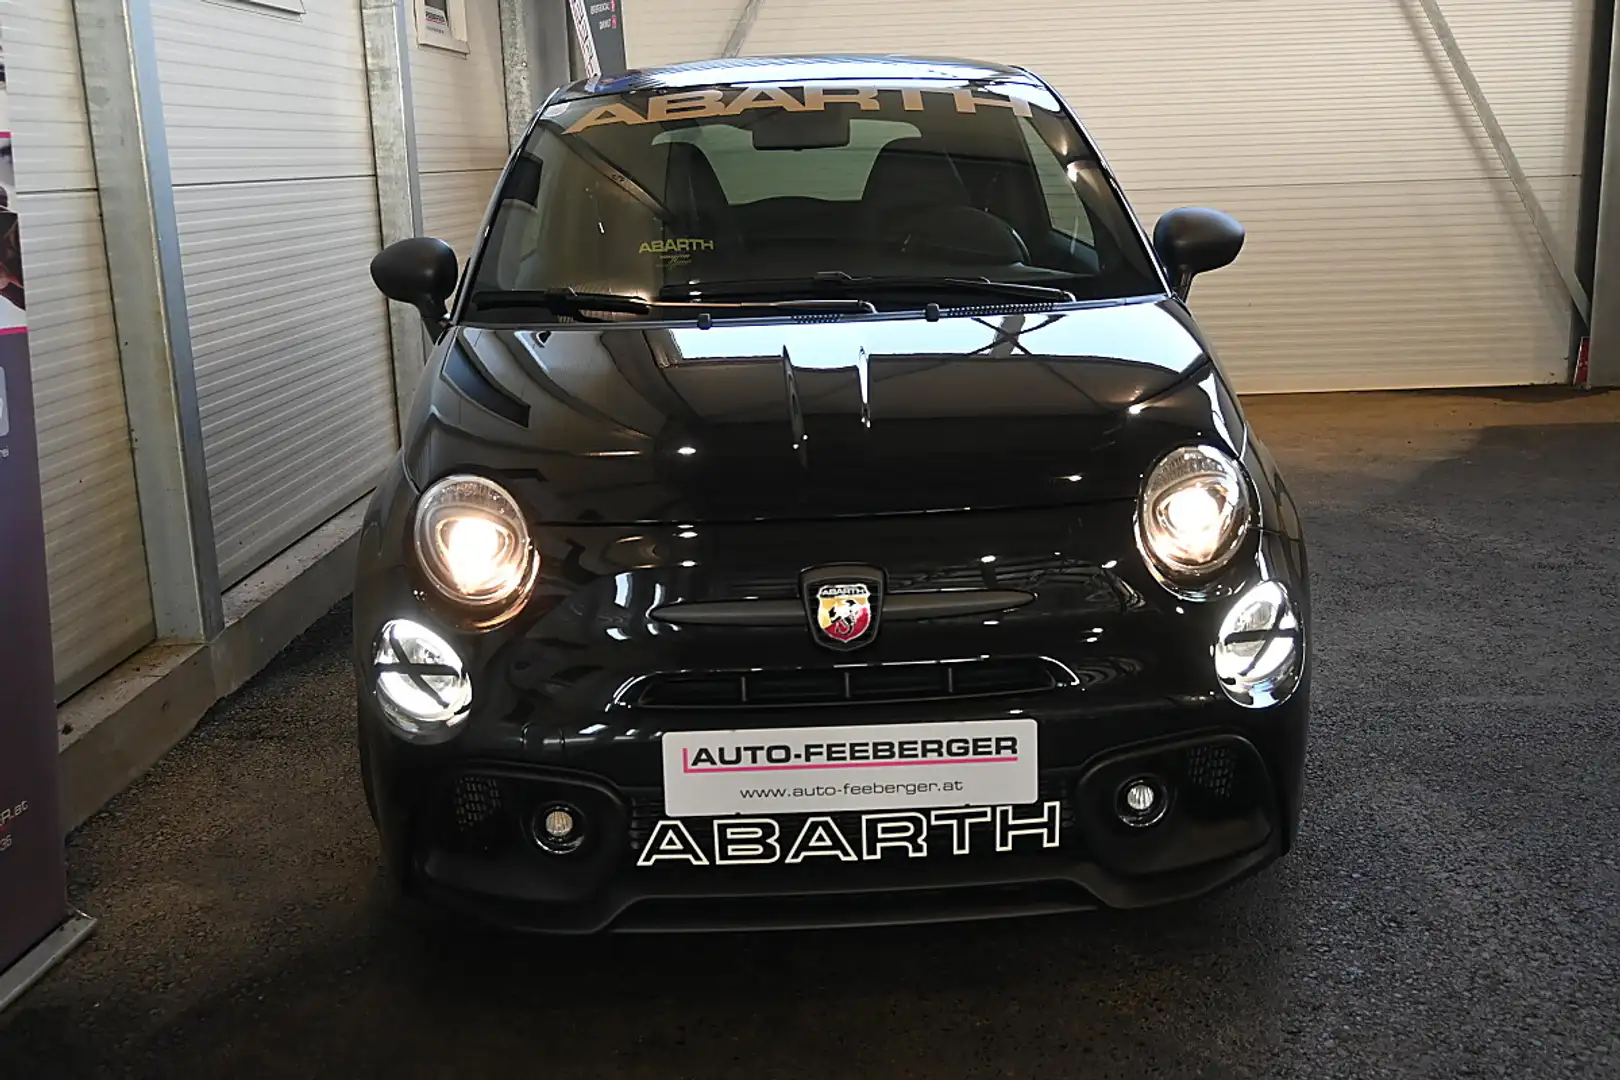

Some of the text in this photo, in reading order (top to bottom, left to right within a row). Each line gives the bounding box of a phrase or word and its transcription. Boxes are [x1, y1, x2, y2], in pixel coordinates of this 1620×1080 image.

[560, 85, 1033, 134] ABARTH
[638, 238, 714, 254] ABARTH
[822, 588, 865, 596] ABARTH
[691, 736, 1018, 767] AUTO-FEEBERGER
[740, 779, 965, 800] www.auto-feeberger.at
[637, 801, 1061, 866] ABARTH
